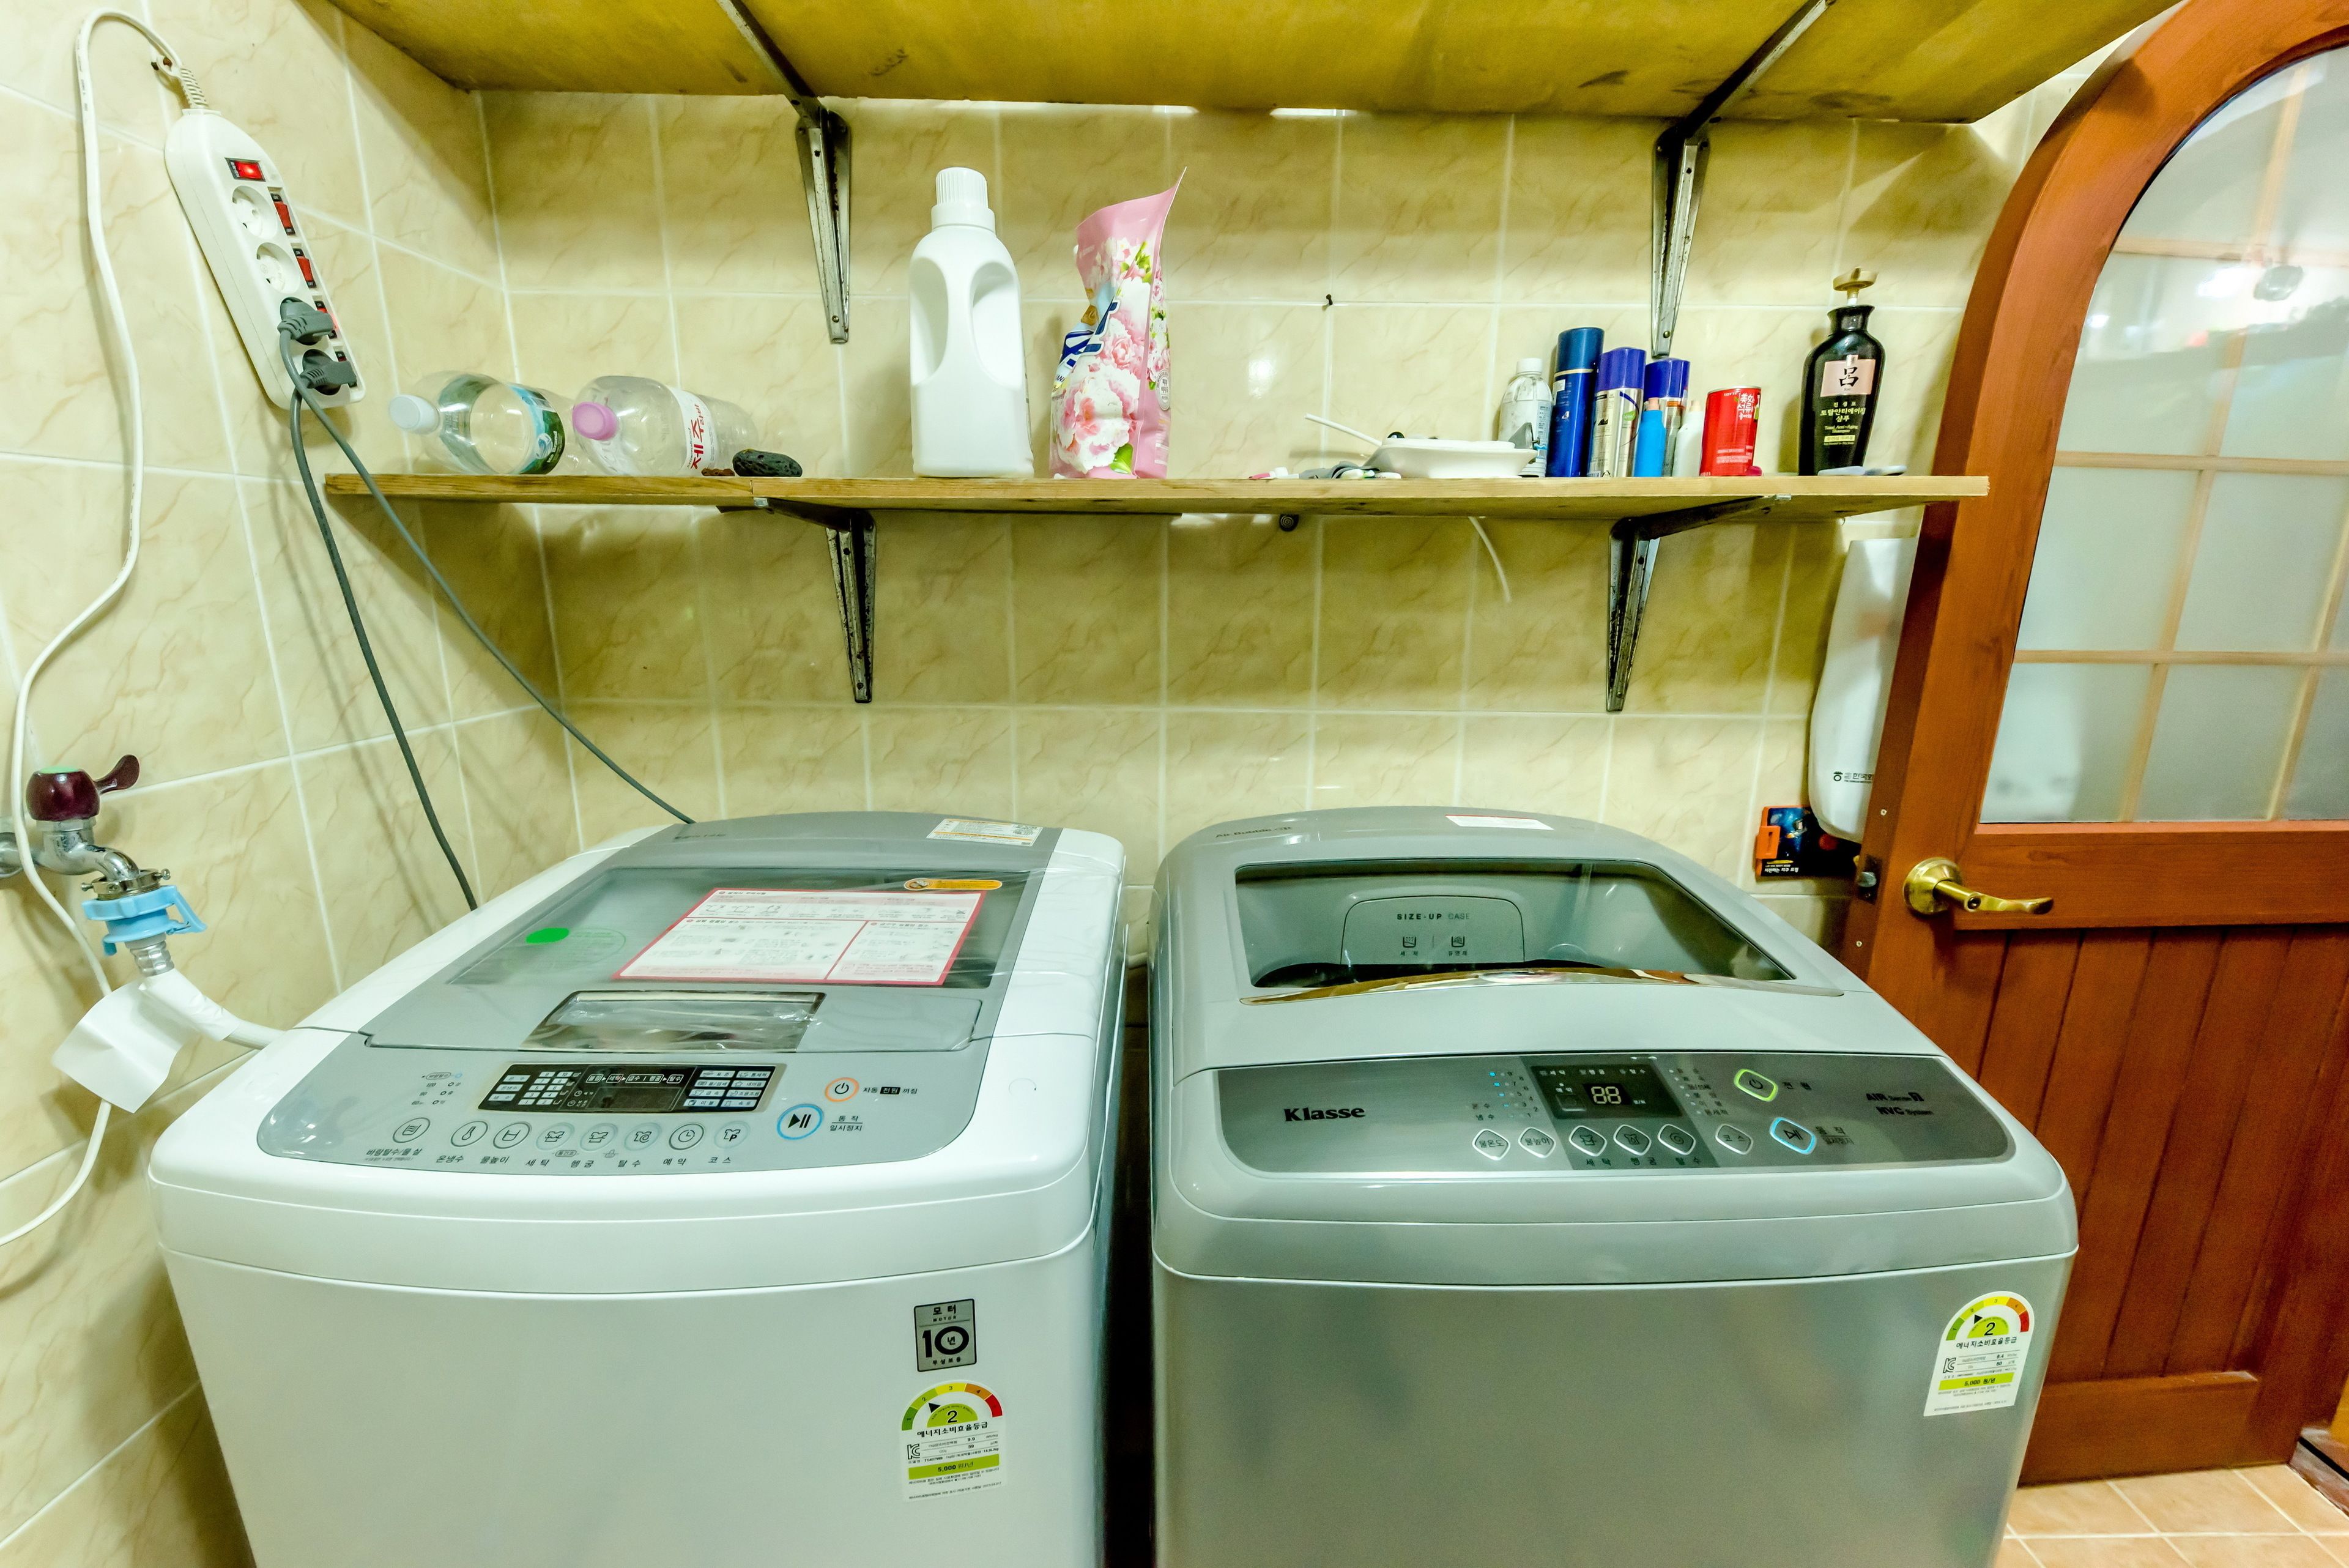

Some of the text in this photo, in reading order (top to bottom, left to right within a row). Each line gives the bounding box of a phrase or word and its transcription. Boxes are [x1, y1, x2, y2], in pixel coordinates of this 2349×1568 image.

[1839, 366, 1858, 387] 呂
[690, 418, 704, 470] 제주
[1590, 1086, 1622, 1105] 88
[1284, 1107, 1366, 1122] Klasse
[480, 1156, 510, 1164] 물높이
[933, 1304, 956, 1315] 모터
[1984, 1322, 1995, 1336] 2
[922, 1326, 970, 1358] 10
[948, 1336, 956, 1345] 년
[1956, 1336, 2017, 1349] 에너지소비효율등급
[947, 1410, 958, 1424] 2
[917, 1421, 988, 1438] 에너지소비효율등급
